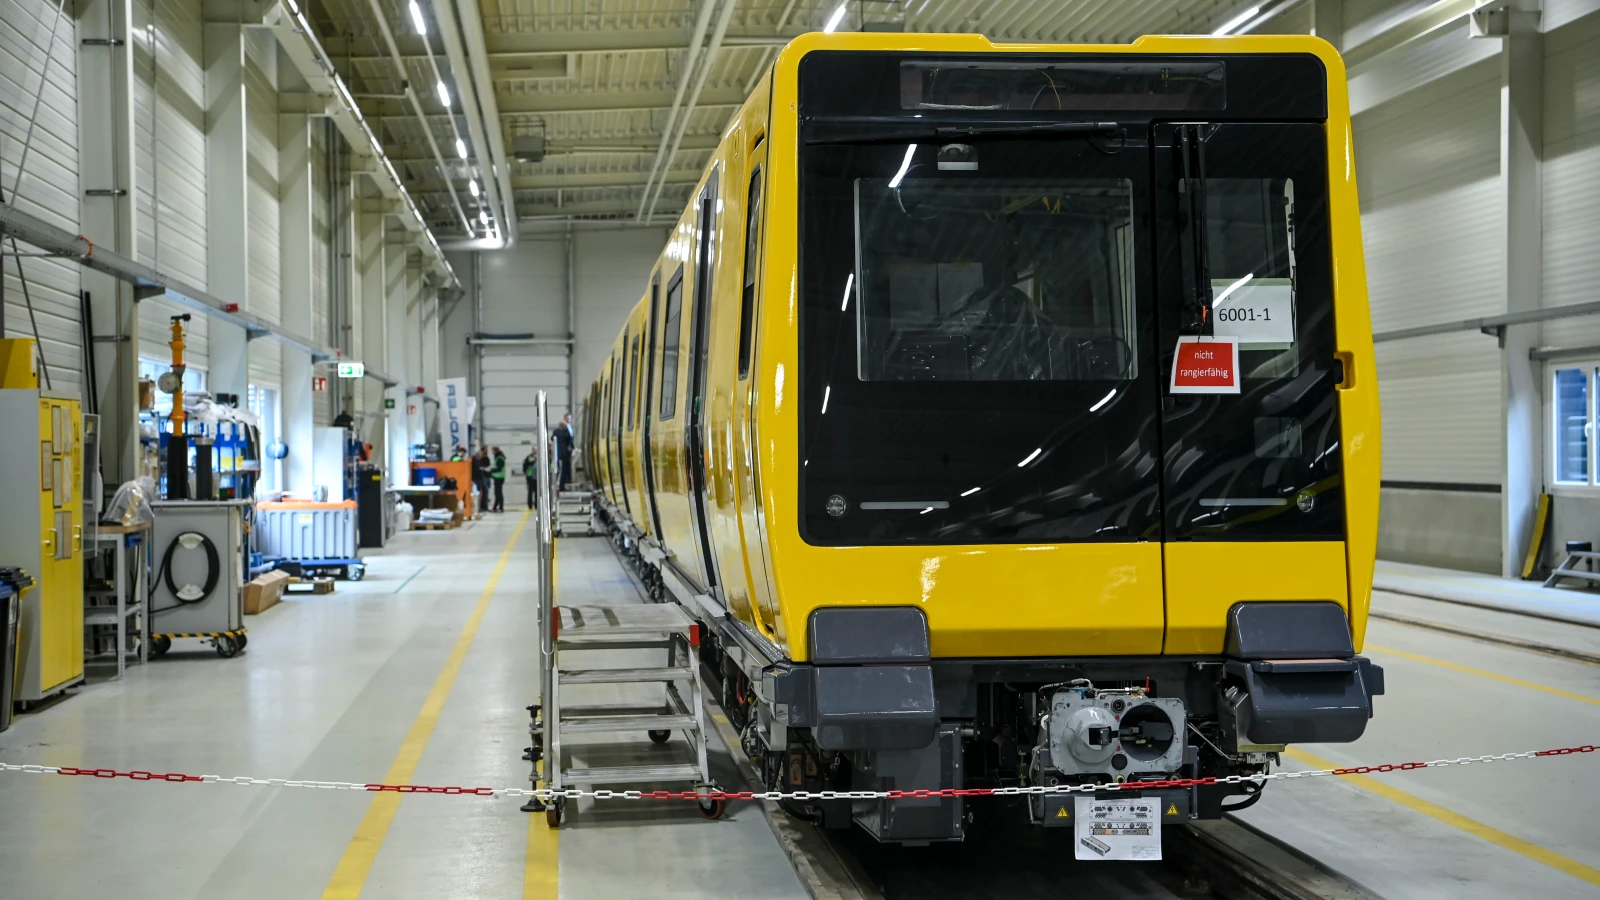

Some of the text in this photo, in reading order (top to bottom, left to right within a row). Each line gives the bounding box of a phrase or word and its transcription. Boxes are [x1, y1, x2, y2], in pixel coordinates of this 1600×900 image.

[1218, 307, 1272, 322] 6001-1
[1194, 350, 1214, 360] nicht
[1180, 367, 1229, 379] rangierfähig
